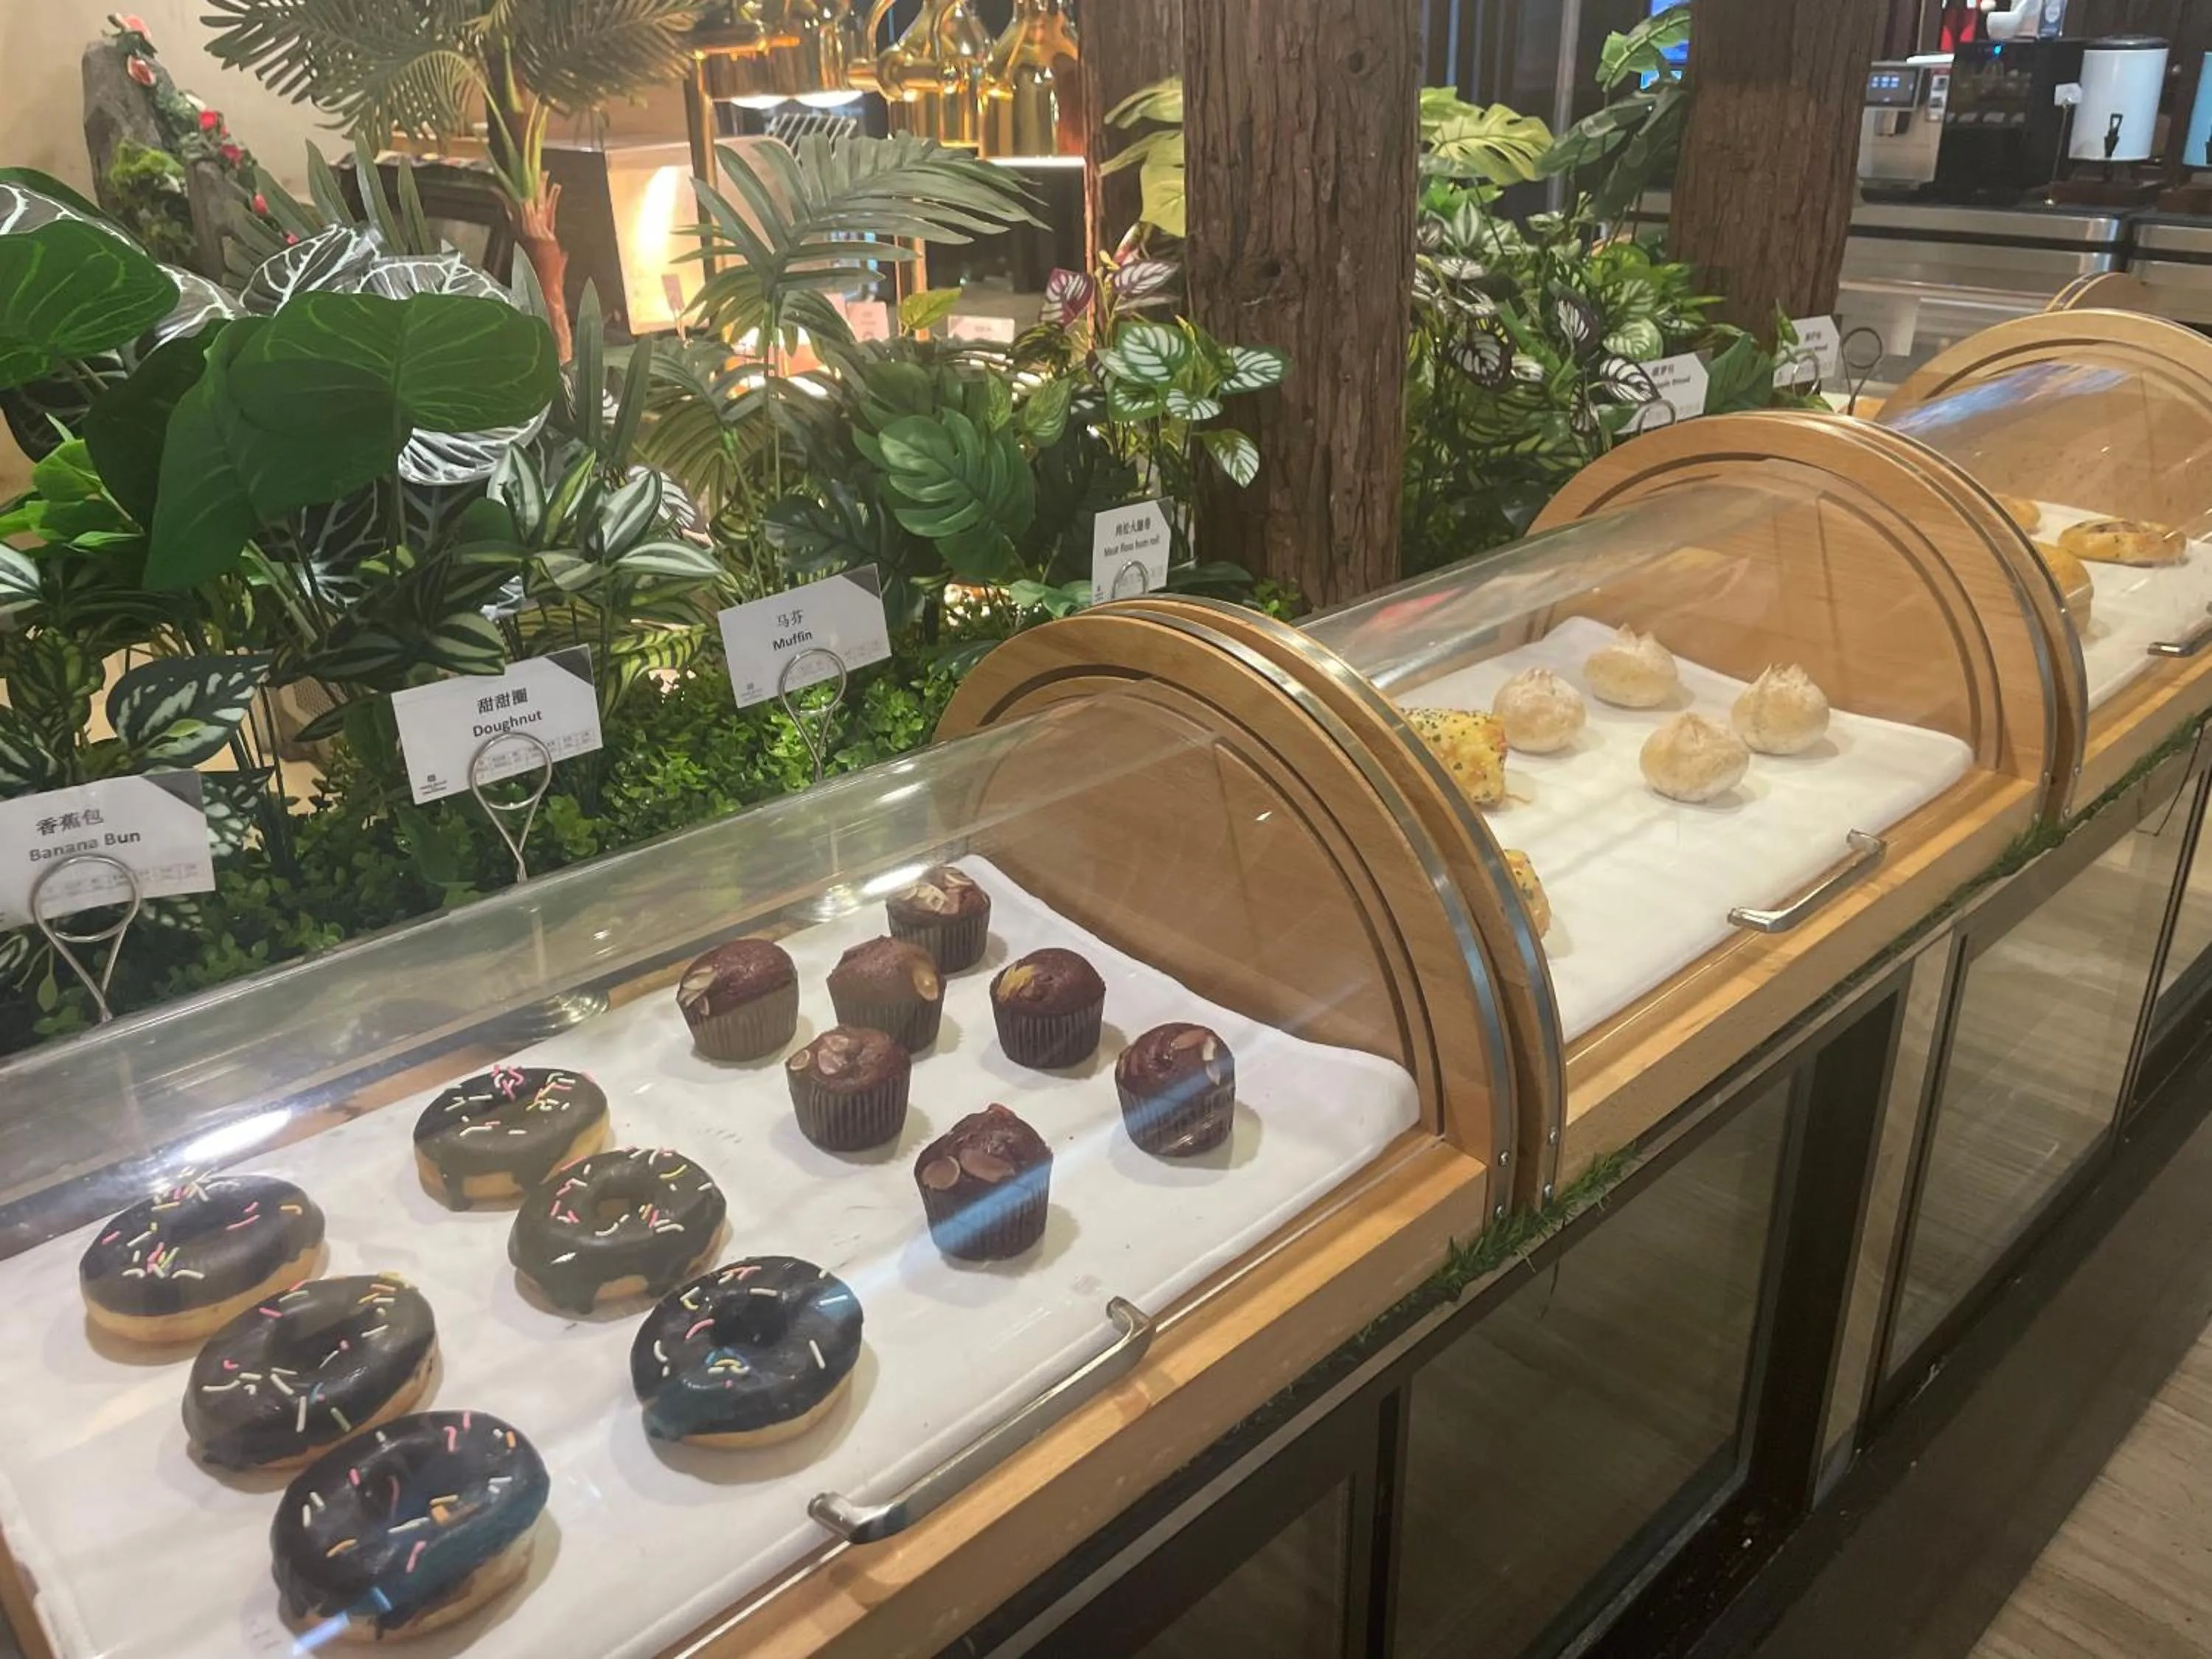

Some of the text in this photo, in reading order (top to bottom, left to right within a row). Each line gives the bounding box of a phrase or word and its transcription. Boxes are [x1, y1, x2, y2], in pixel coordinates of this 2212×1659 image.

[777, 609, 804, 627] 马芬
[773, 630, 813, 650] Muffin
[473, 710, 543, 737] Doughnut
[36, 808, 105, 836] 香蕉包
[29, 831, 141, 862] Banana Bun
